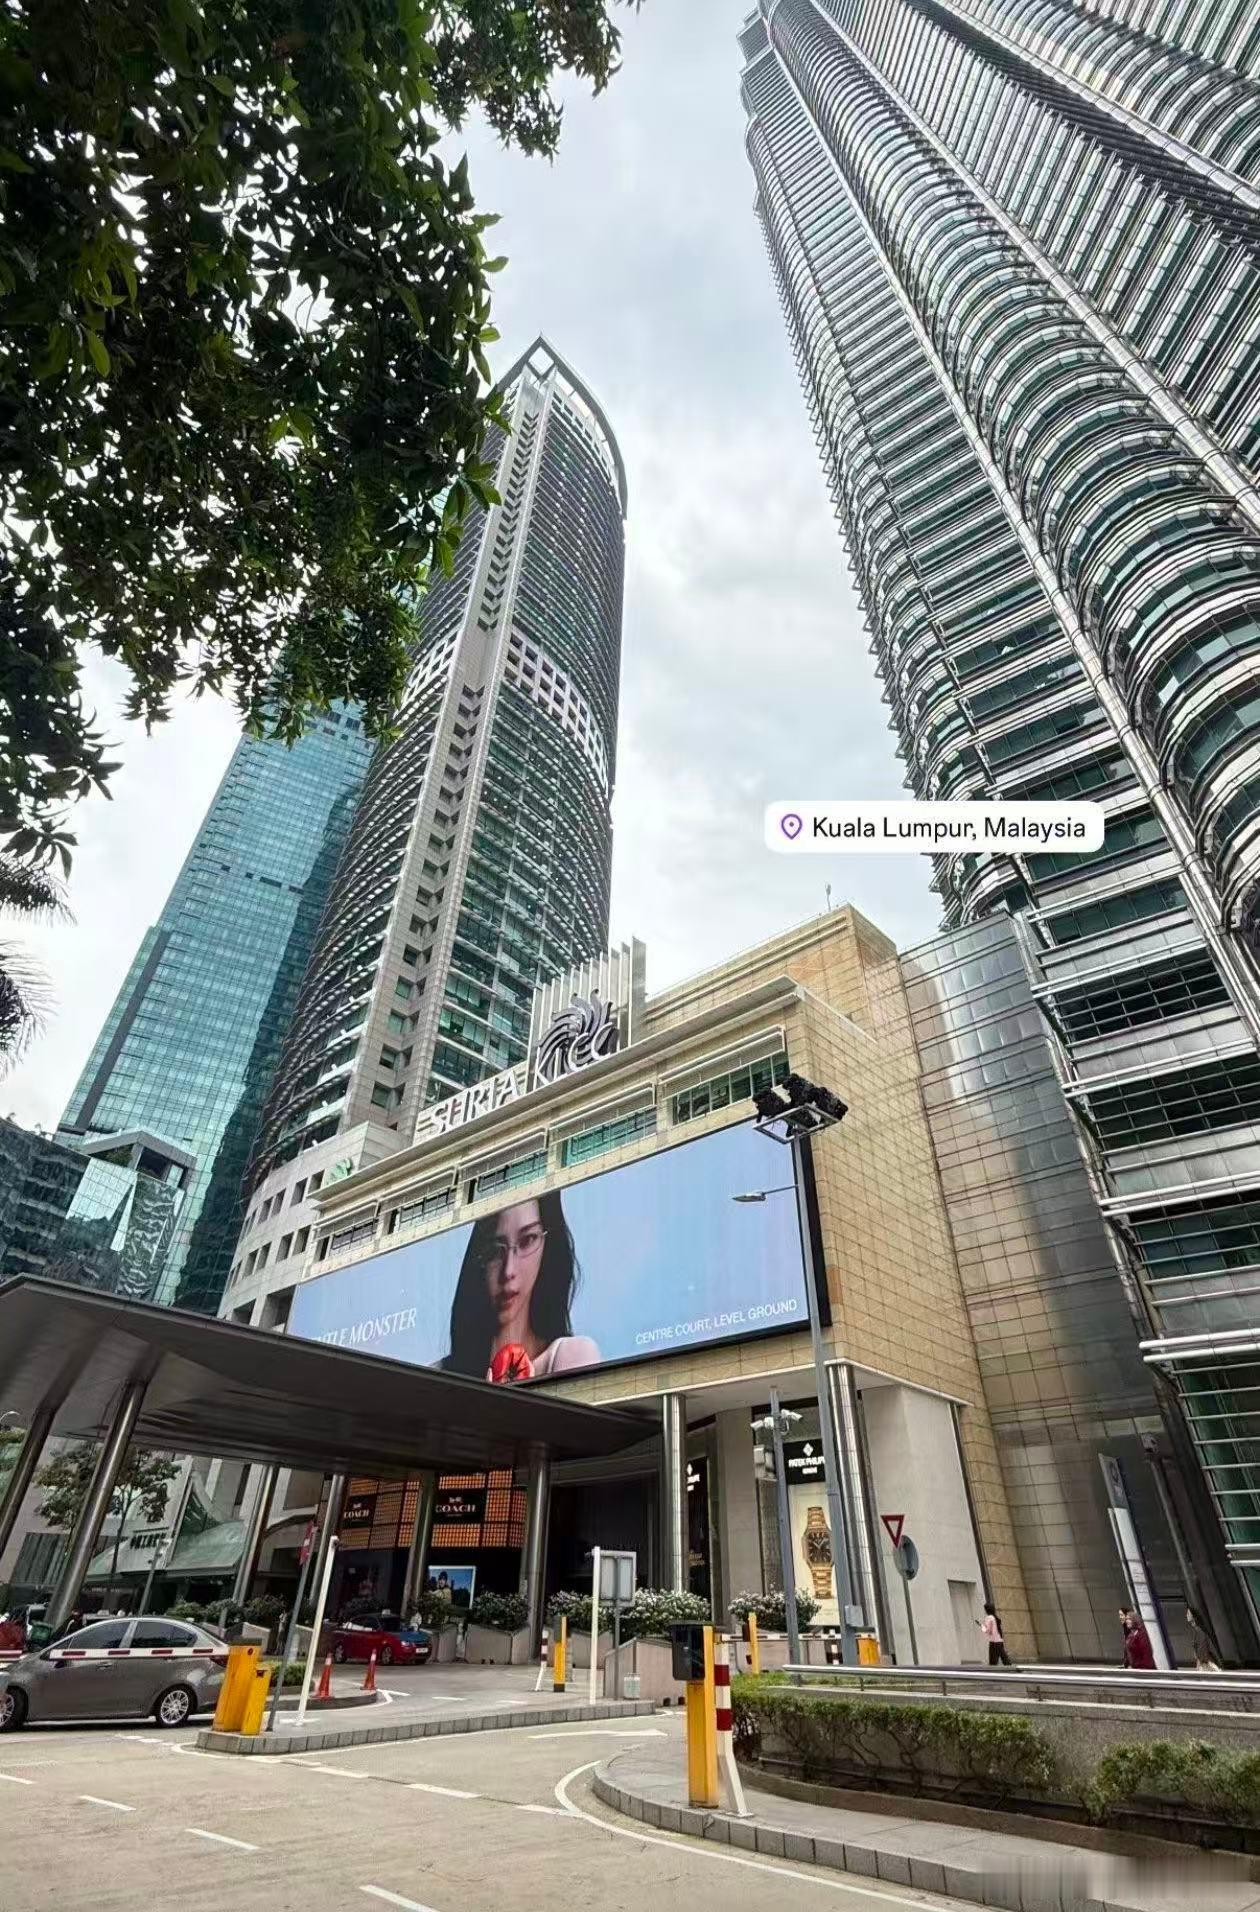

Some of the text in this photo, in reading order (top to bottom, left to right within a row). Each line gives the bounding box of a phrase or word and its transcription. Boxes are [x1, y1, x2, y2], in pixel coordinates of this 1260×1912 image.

[348, 1307, 417, 1346] MONSTER
[635, 1298, 798, 1345] CENTRE COURT, LEVEL GROUND
[343, 1509, 370, 1519] COACH
[435, 1504, 476, 1513] COACH
